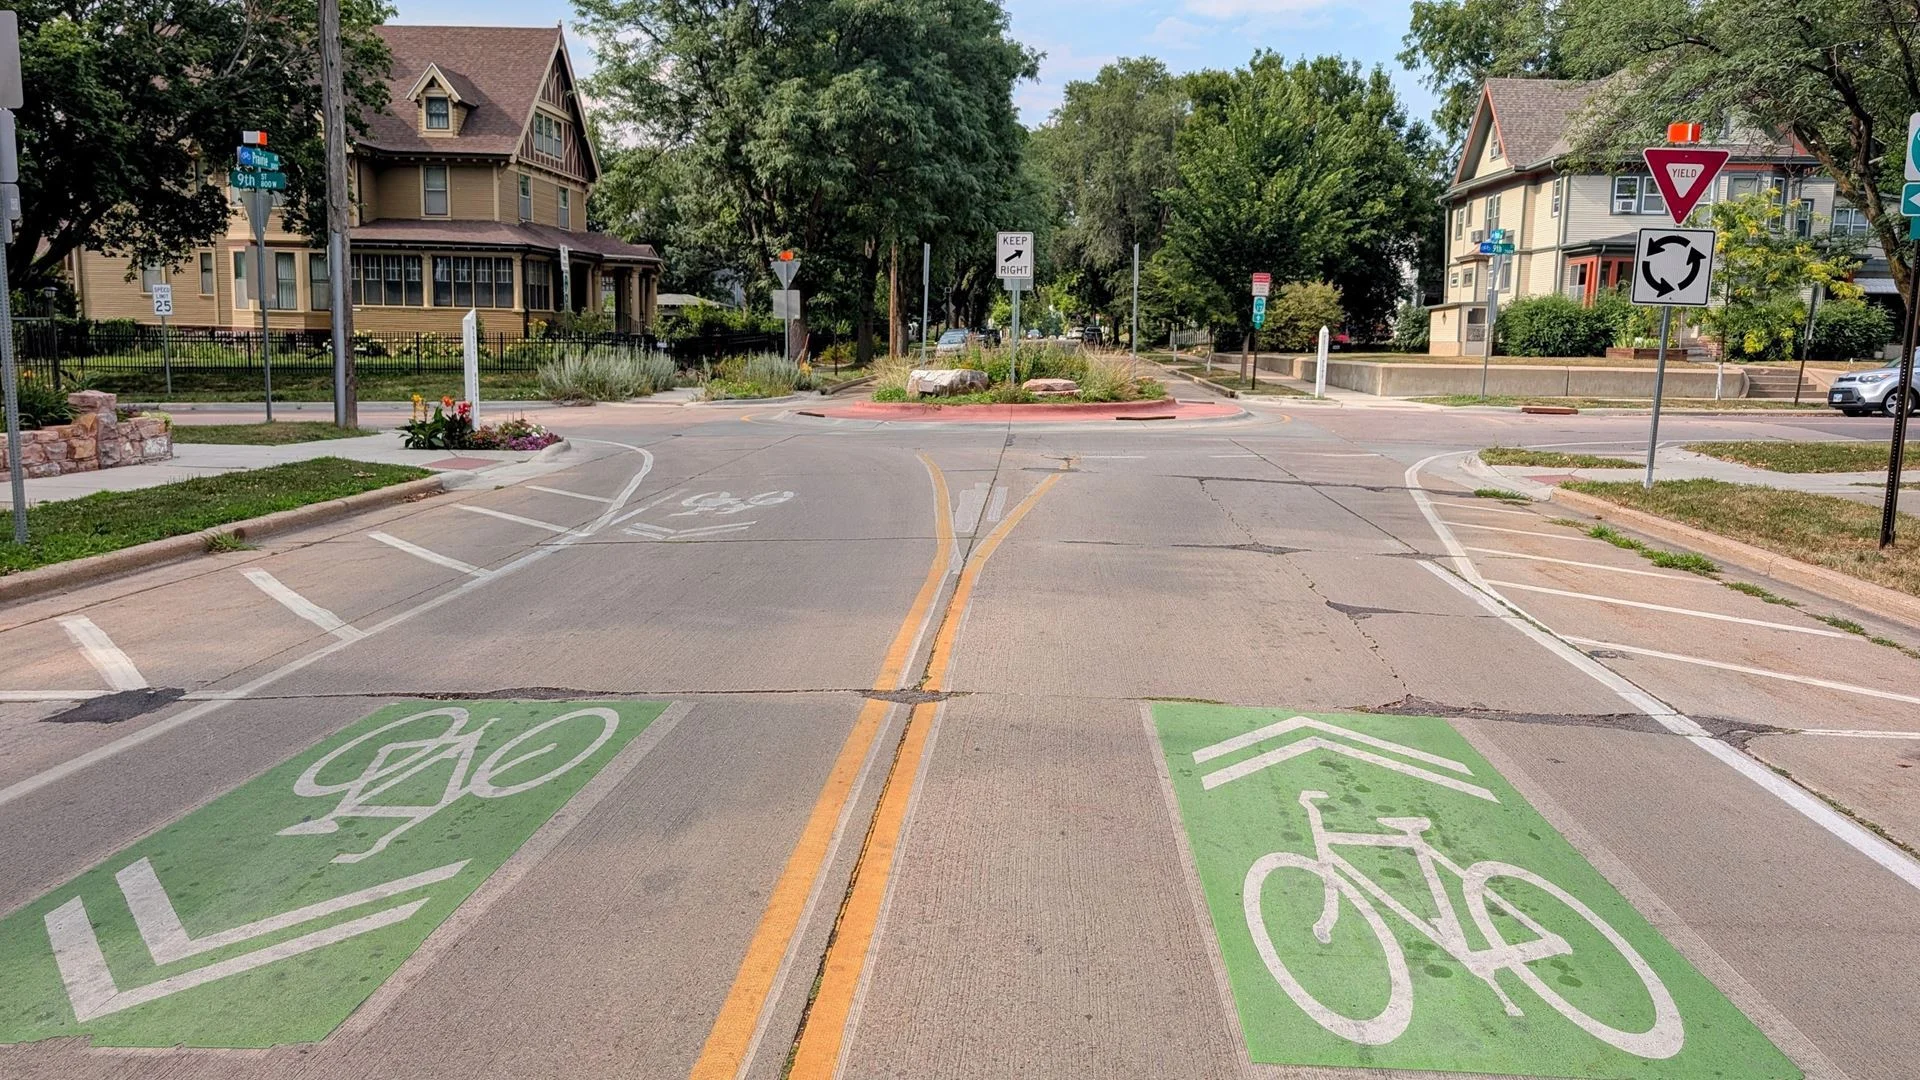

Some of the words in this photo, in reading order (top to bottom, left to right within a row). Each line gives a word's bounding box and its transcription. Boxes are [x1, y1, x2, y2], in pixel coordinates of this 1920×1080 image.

[252, 151, 268, 167] Prairie
[1672, 168, 1697, 178] YIELD
[237, 173, 255, 187] 9th
[1003, 236, 1028, 245] KEEP
[1000, 265, 1029, 275] RIGHT
[155, 300, 172, 312] 25
